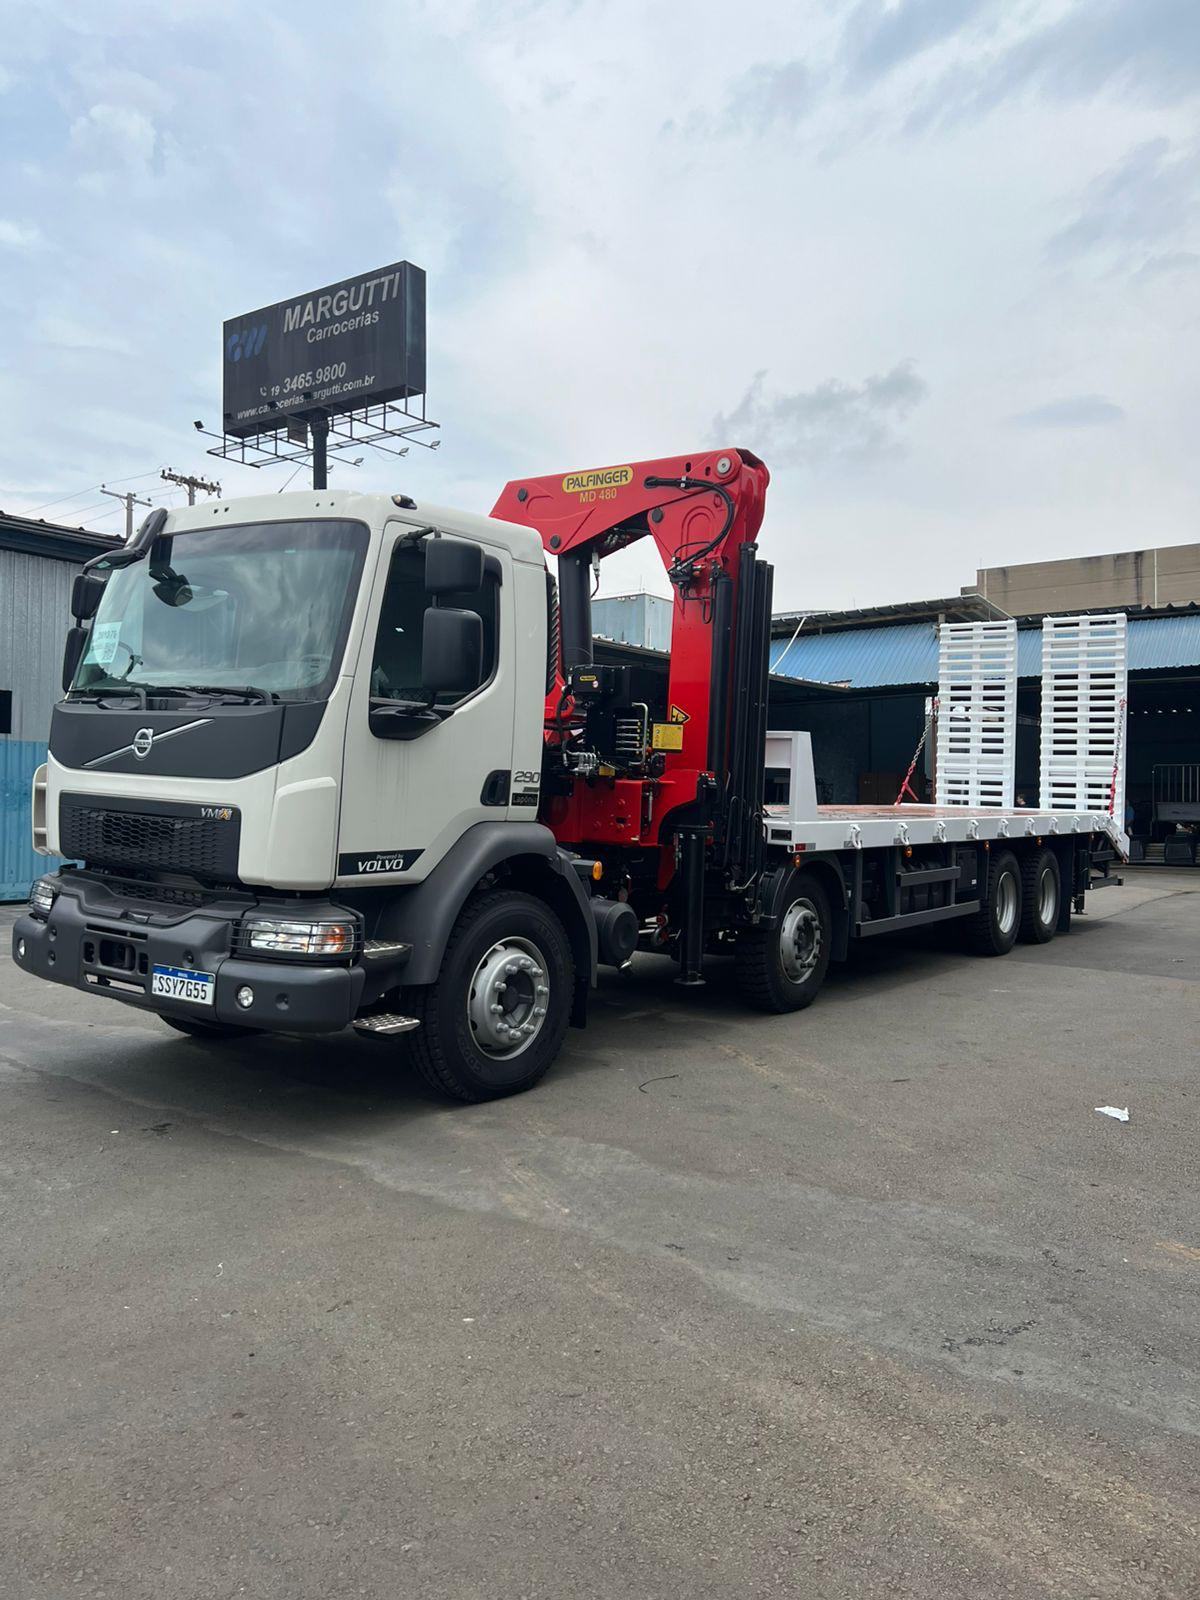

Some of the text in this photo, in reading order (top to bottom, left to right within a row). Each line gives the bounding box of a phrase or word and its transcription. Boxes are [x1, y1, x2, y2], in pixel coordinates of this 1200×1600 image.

[283, 273, 400, 333] MARGUTTI
[307, 310, 380, 343] Carrocerias
[270, 362, 346, 397] 19 3465.9800
[237, 374, 375, 419] www.caceriasargutti.com.br
[566, 469, 628, 490] PALFINGER
[580, 488, 617, 503] MD 480
[513, 771, 540, 783] 290
[358, 859, 403, 872] VOLVO
[158, 976, 207, 1000] SSY7G55
